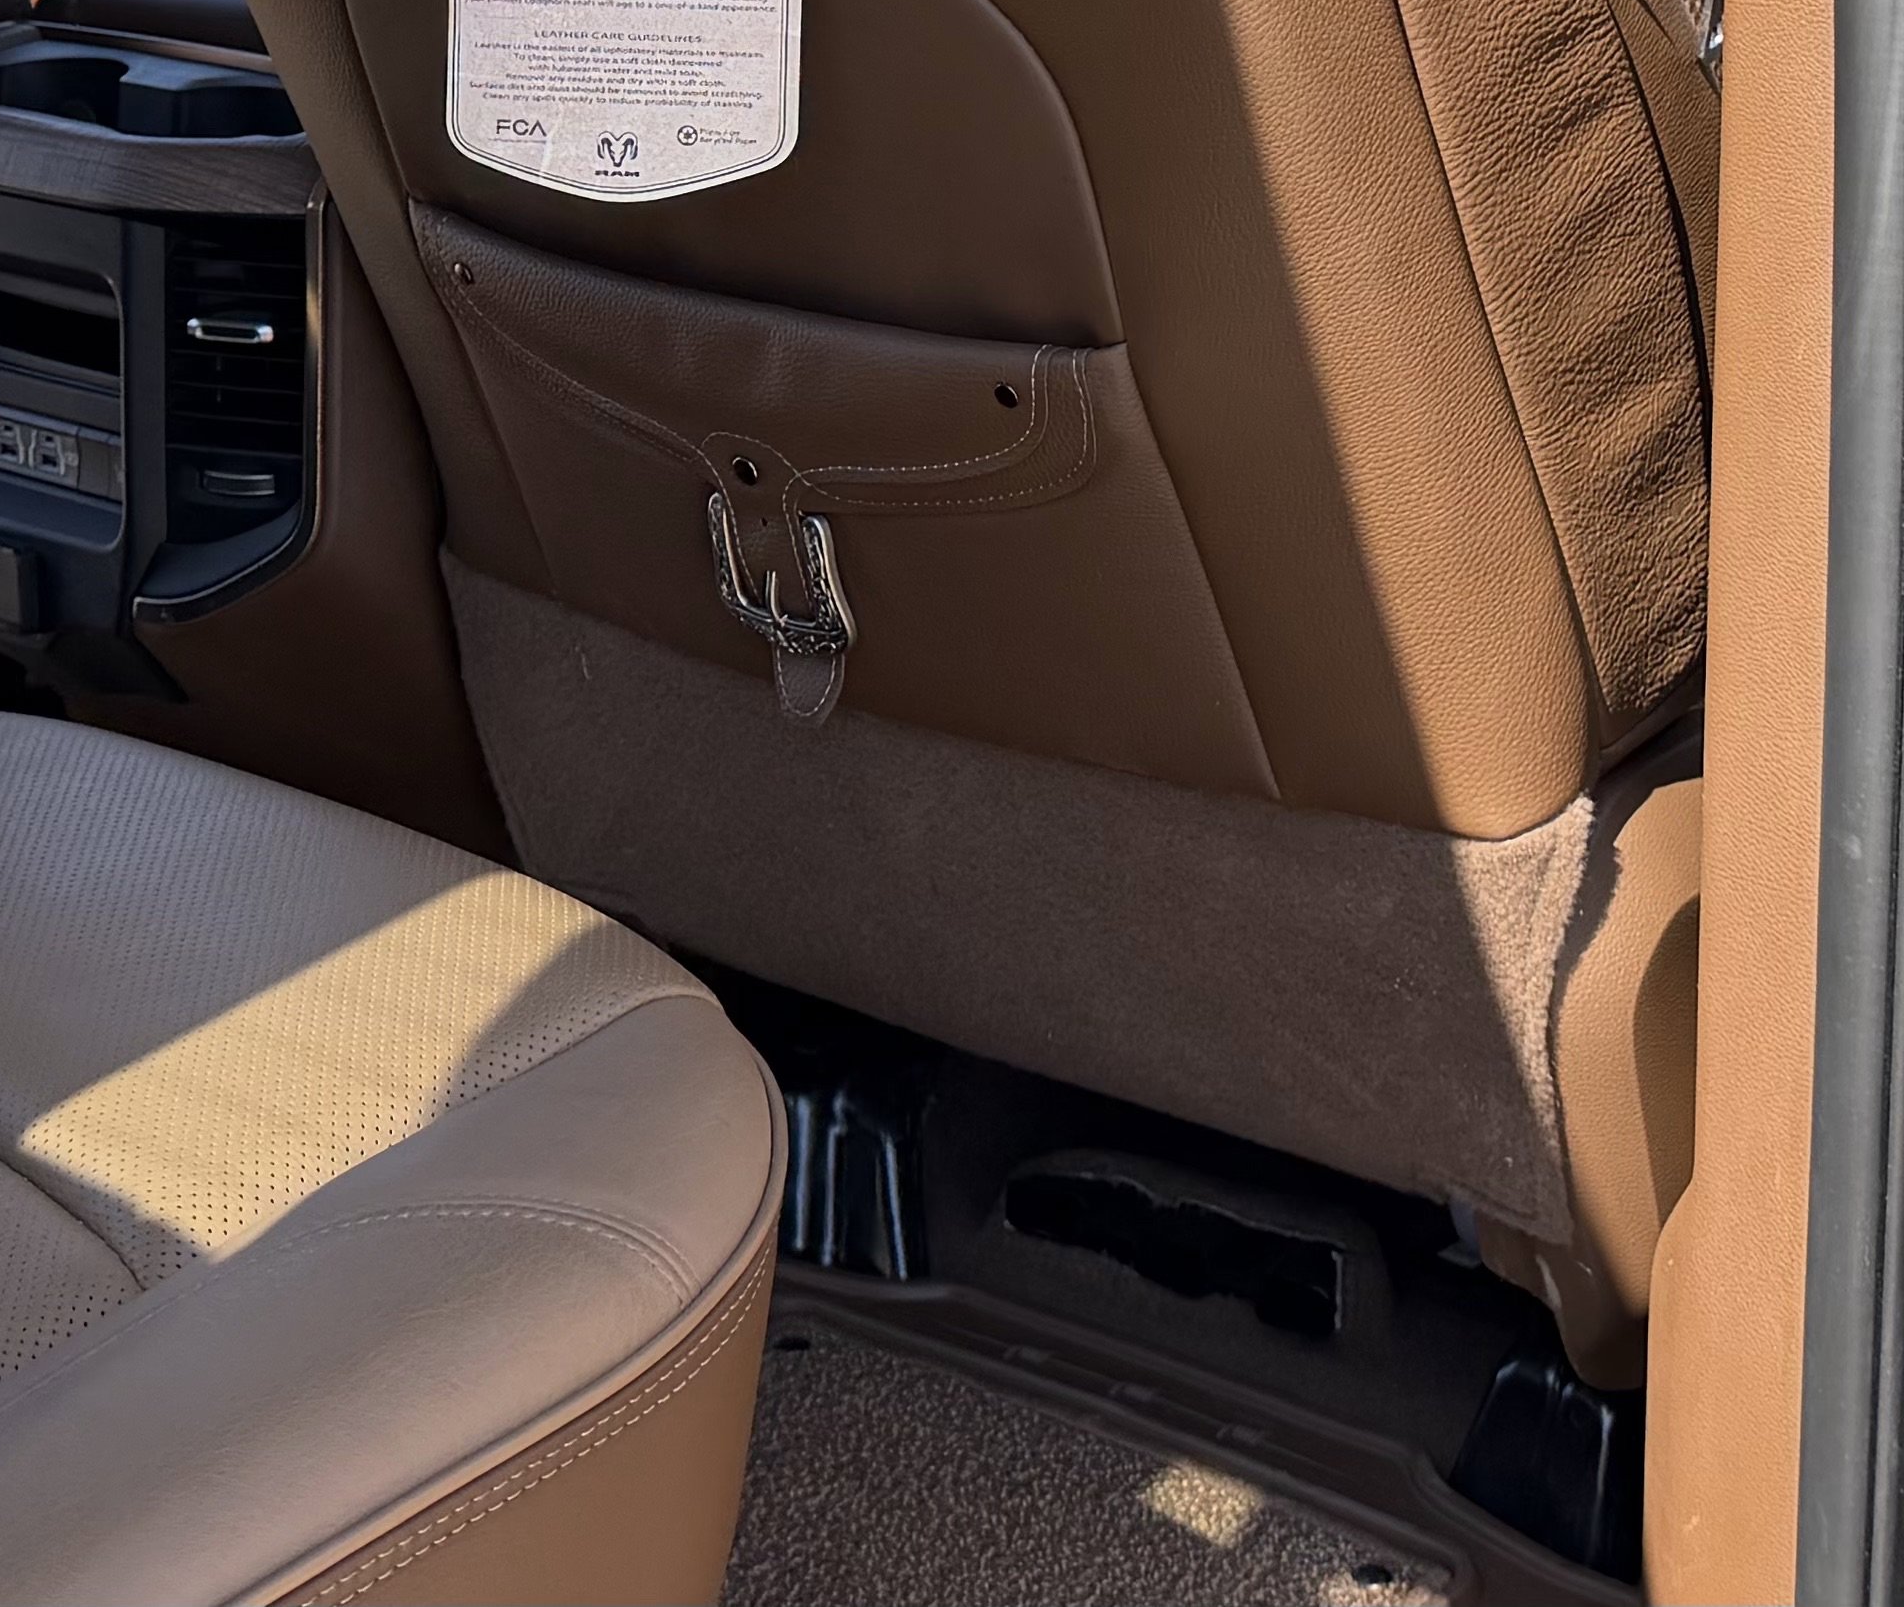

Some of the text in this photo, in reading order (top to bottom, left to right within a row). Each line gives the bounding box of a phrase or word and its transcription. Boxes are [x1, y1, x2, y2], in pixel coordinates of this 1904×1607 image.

[532, 29, 588, 39] LEATHER
[590, 31, 625, 40] CARE
[495, 118, 547, 136] FCA
[593, 169, 640, 177] RAM
